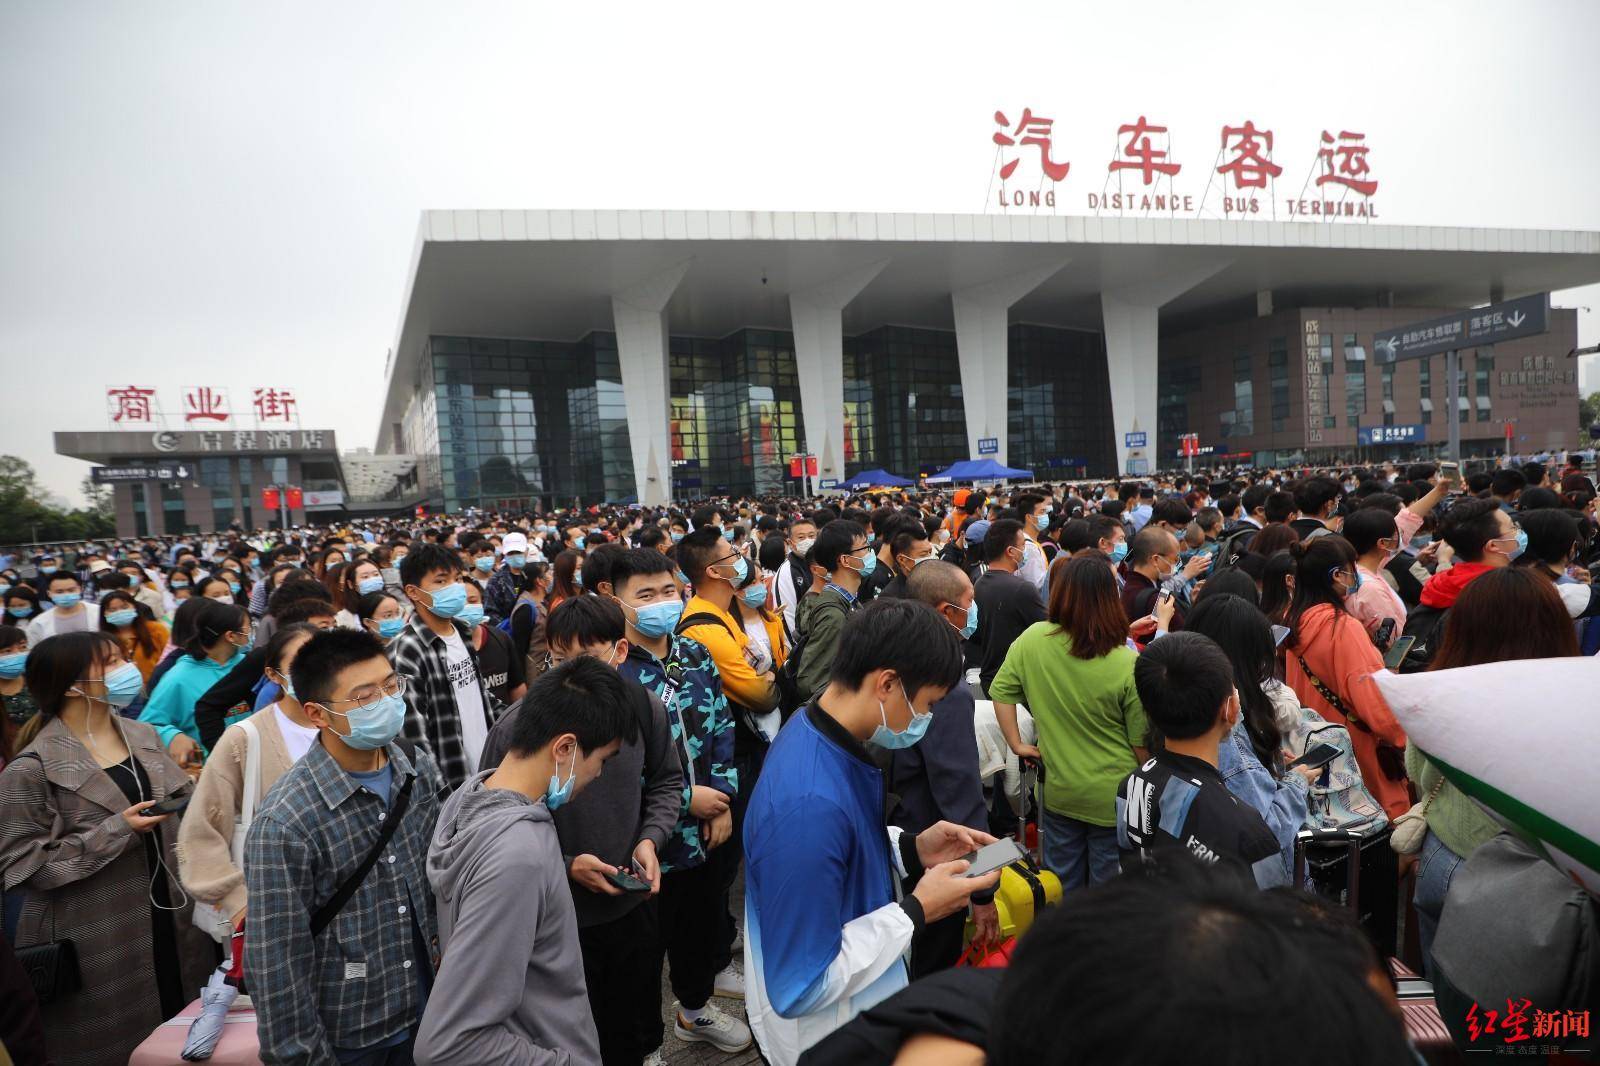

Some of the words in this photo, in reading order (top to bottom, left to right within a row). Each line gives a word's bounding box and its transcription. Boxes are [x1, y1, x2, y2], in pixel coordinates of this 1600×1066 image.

[993, 107, 1378, 195] 汽车客运
[998, 189, 1056, 207] LONG
[1088, 193, 1194, 212] DISTANCE
[1223, 197, 1260, 214] BUS
[1286, 199, 1379, 218] TERMINAL
[108, 385, 296, 422] 商业街
